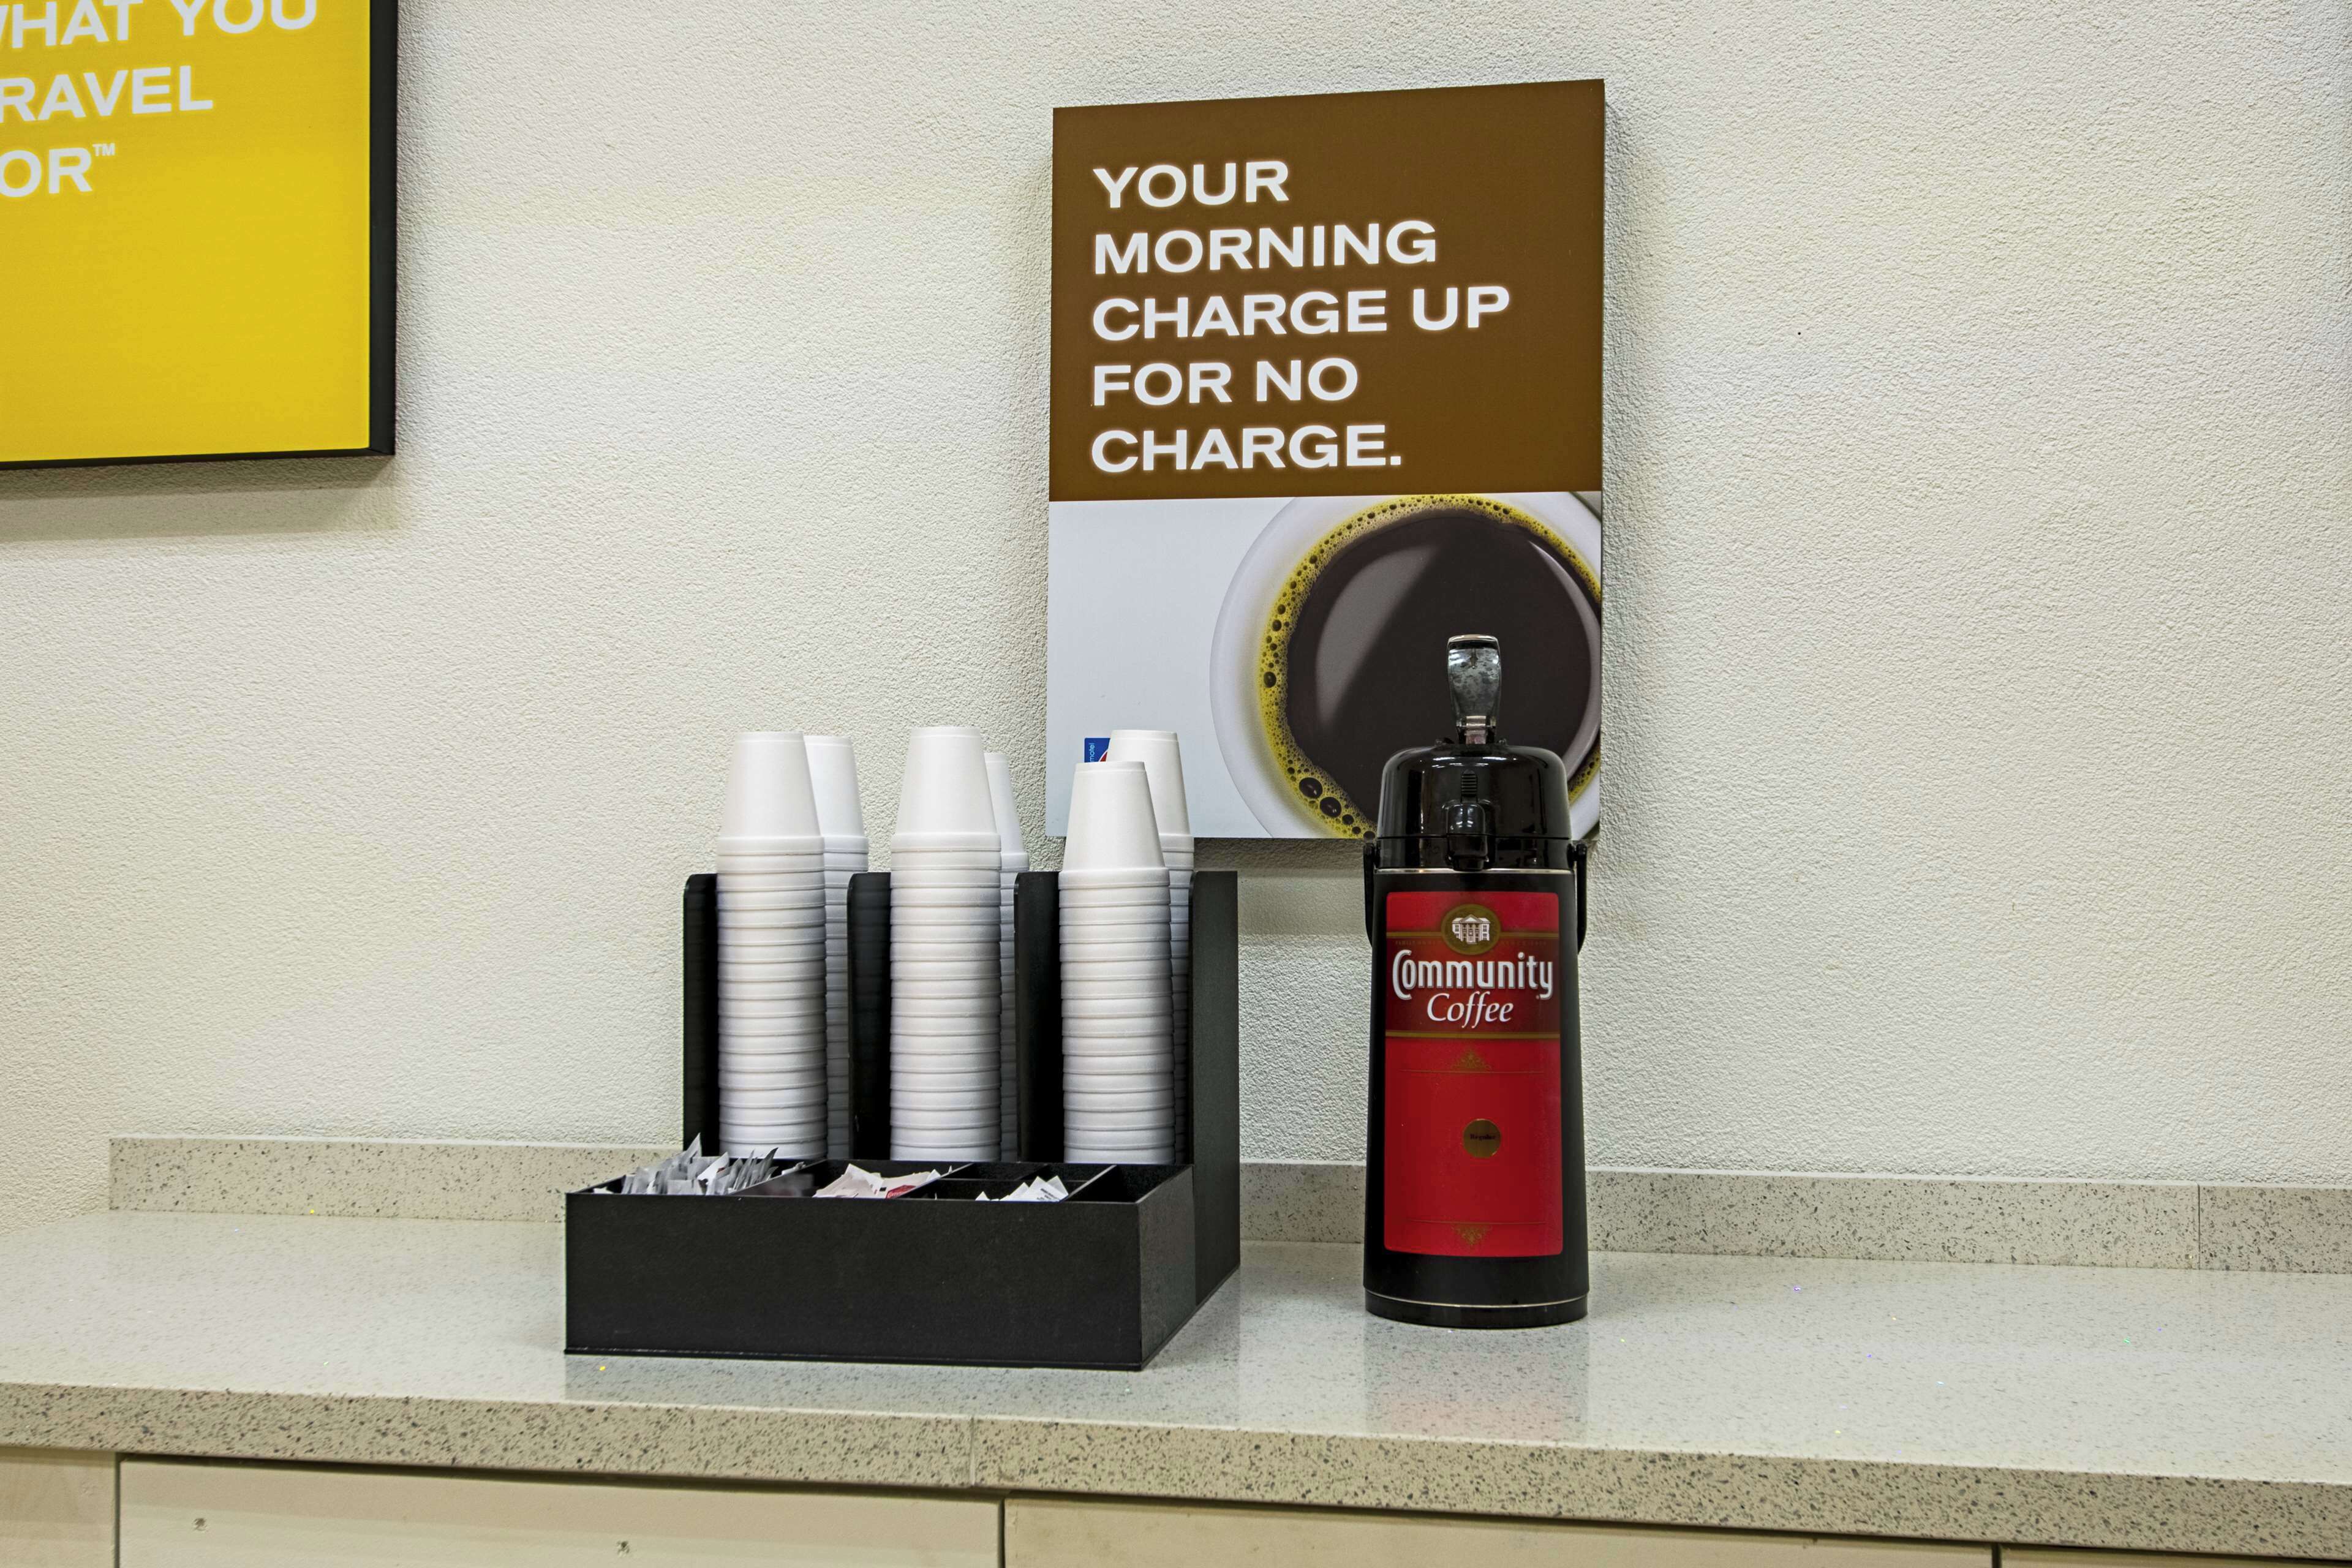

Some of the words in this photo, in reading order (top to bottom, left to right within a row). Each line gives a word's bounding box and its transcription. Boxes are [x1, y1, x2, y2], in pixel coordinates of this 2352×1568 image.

[0, 0, 143, 48] HAT
[170, 0, 317, 36] YOU
[1093, 160, 1289, 208] YOUR
[1095, 220, 1436, 274] MORNING
[1093, 290, 1387, 341] CHARGE
[1413, 285, 1510, 331] UP
[1093, 362, 1232, 406] FOR
[1256, 357, 1358, 402] NO
[1091, 424, 1401, 473] CHARGE.
[1392, 949, 1553, 1000] Community
[1427, 991, 1514, 1029] Coffee
